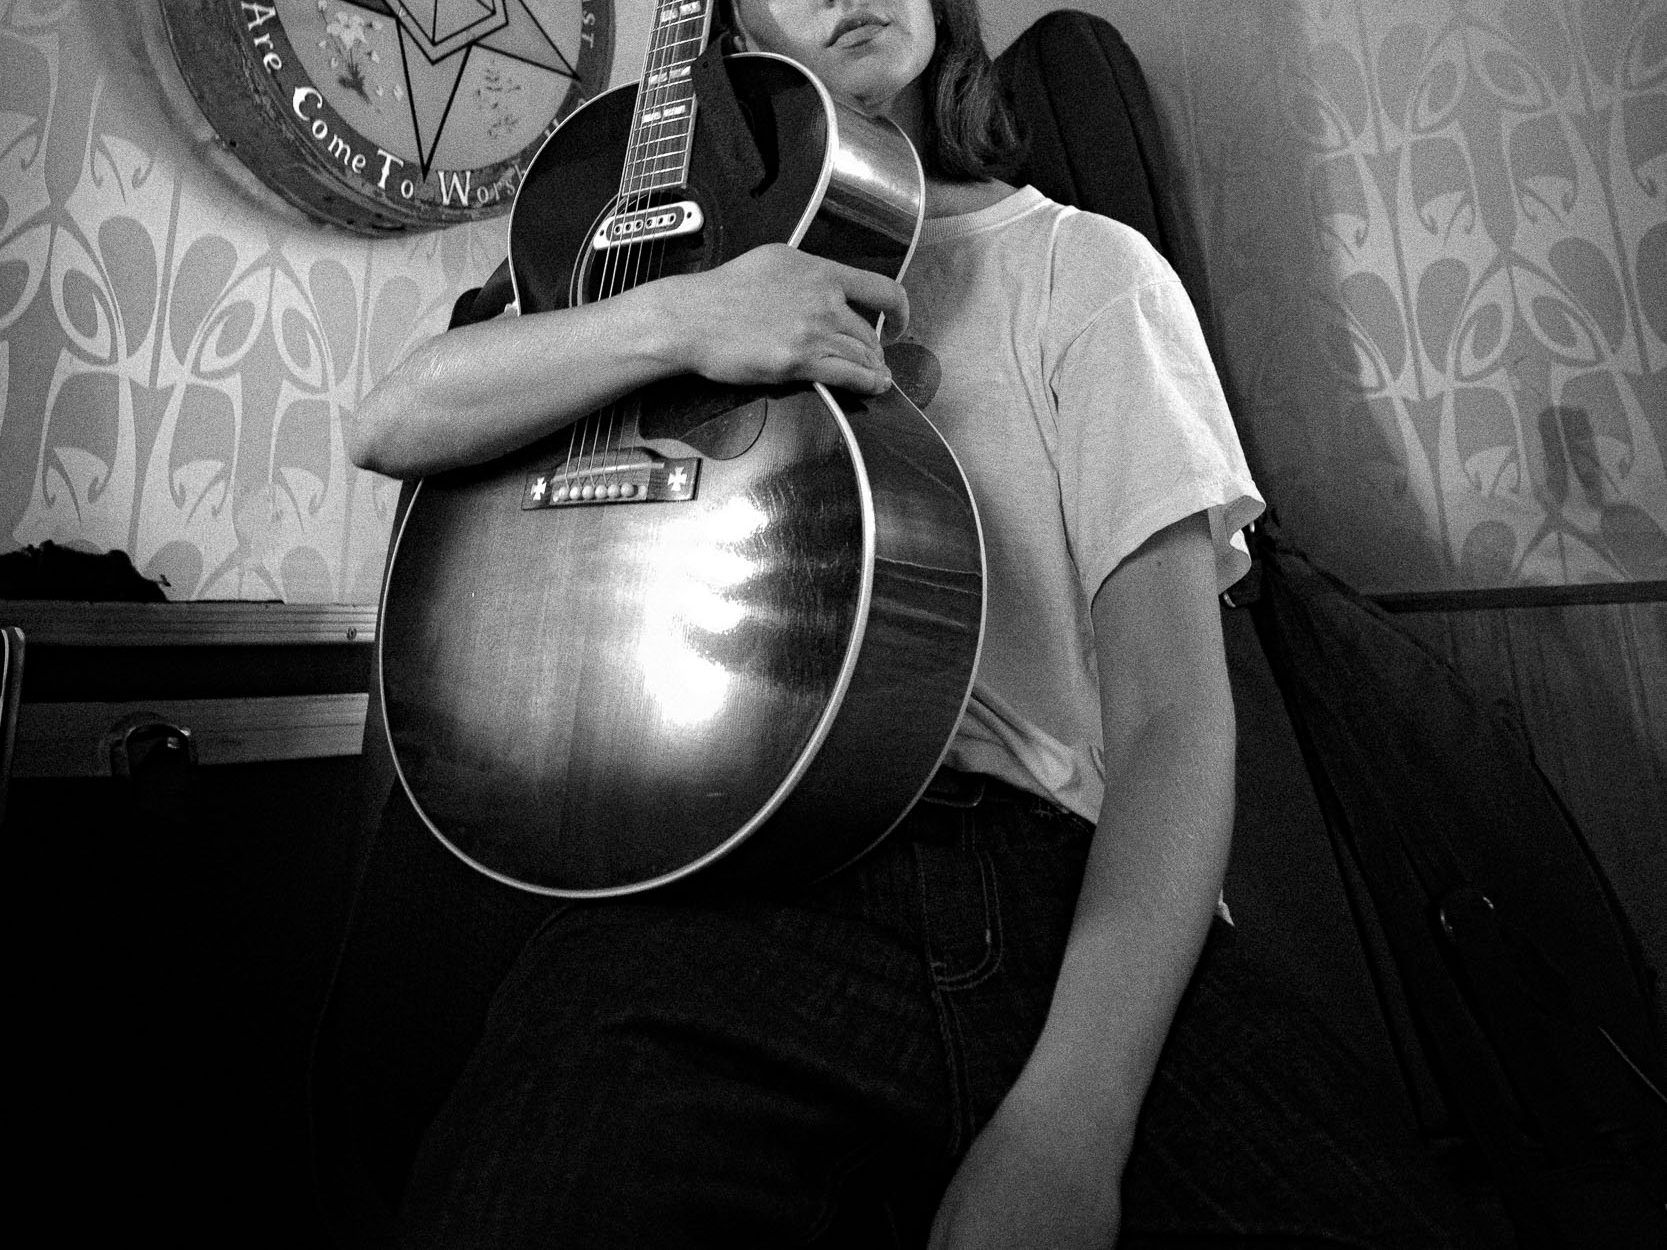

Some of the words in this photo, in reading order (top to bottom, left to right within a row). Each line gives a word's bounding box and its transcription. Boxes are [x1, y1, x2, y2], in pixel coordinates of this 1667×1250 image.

[240, 0, 284, 73] Are
[291, 86, 367, 174] Come
[376, 148, 415, 200] To
